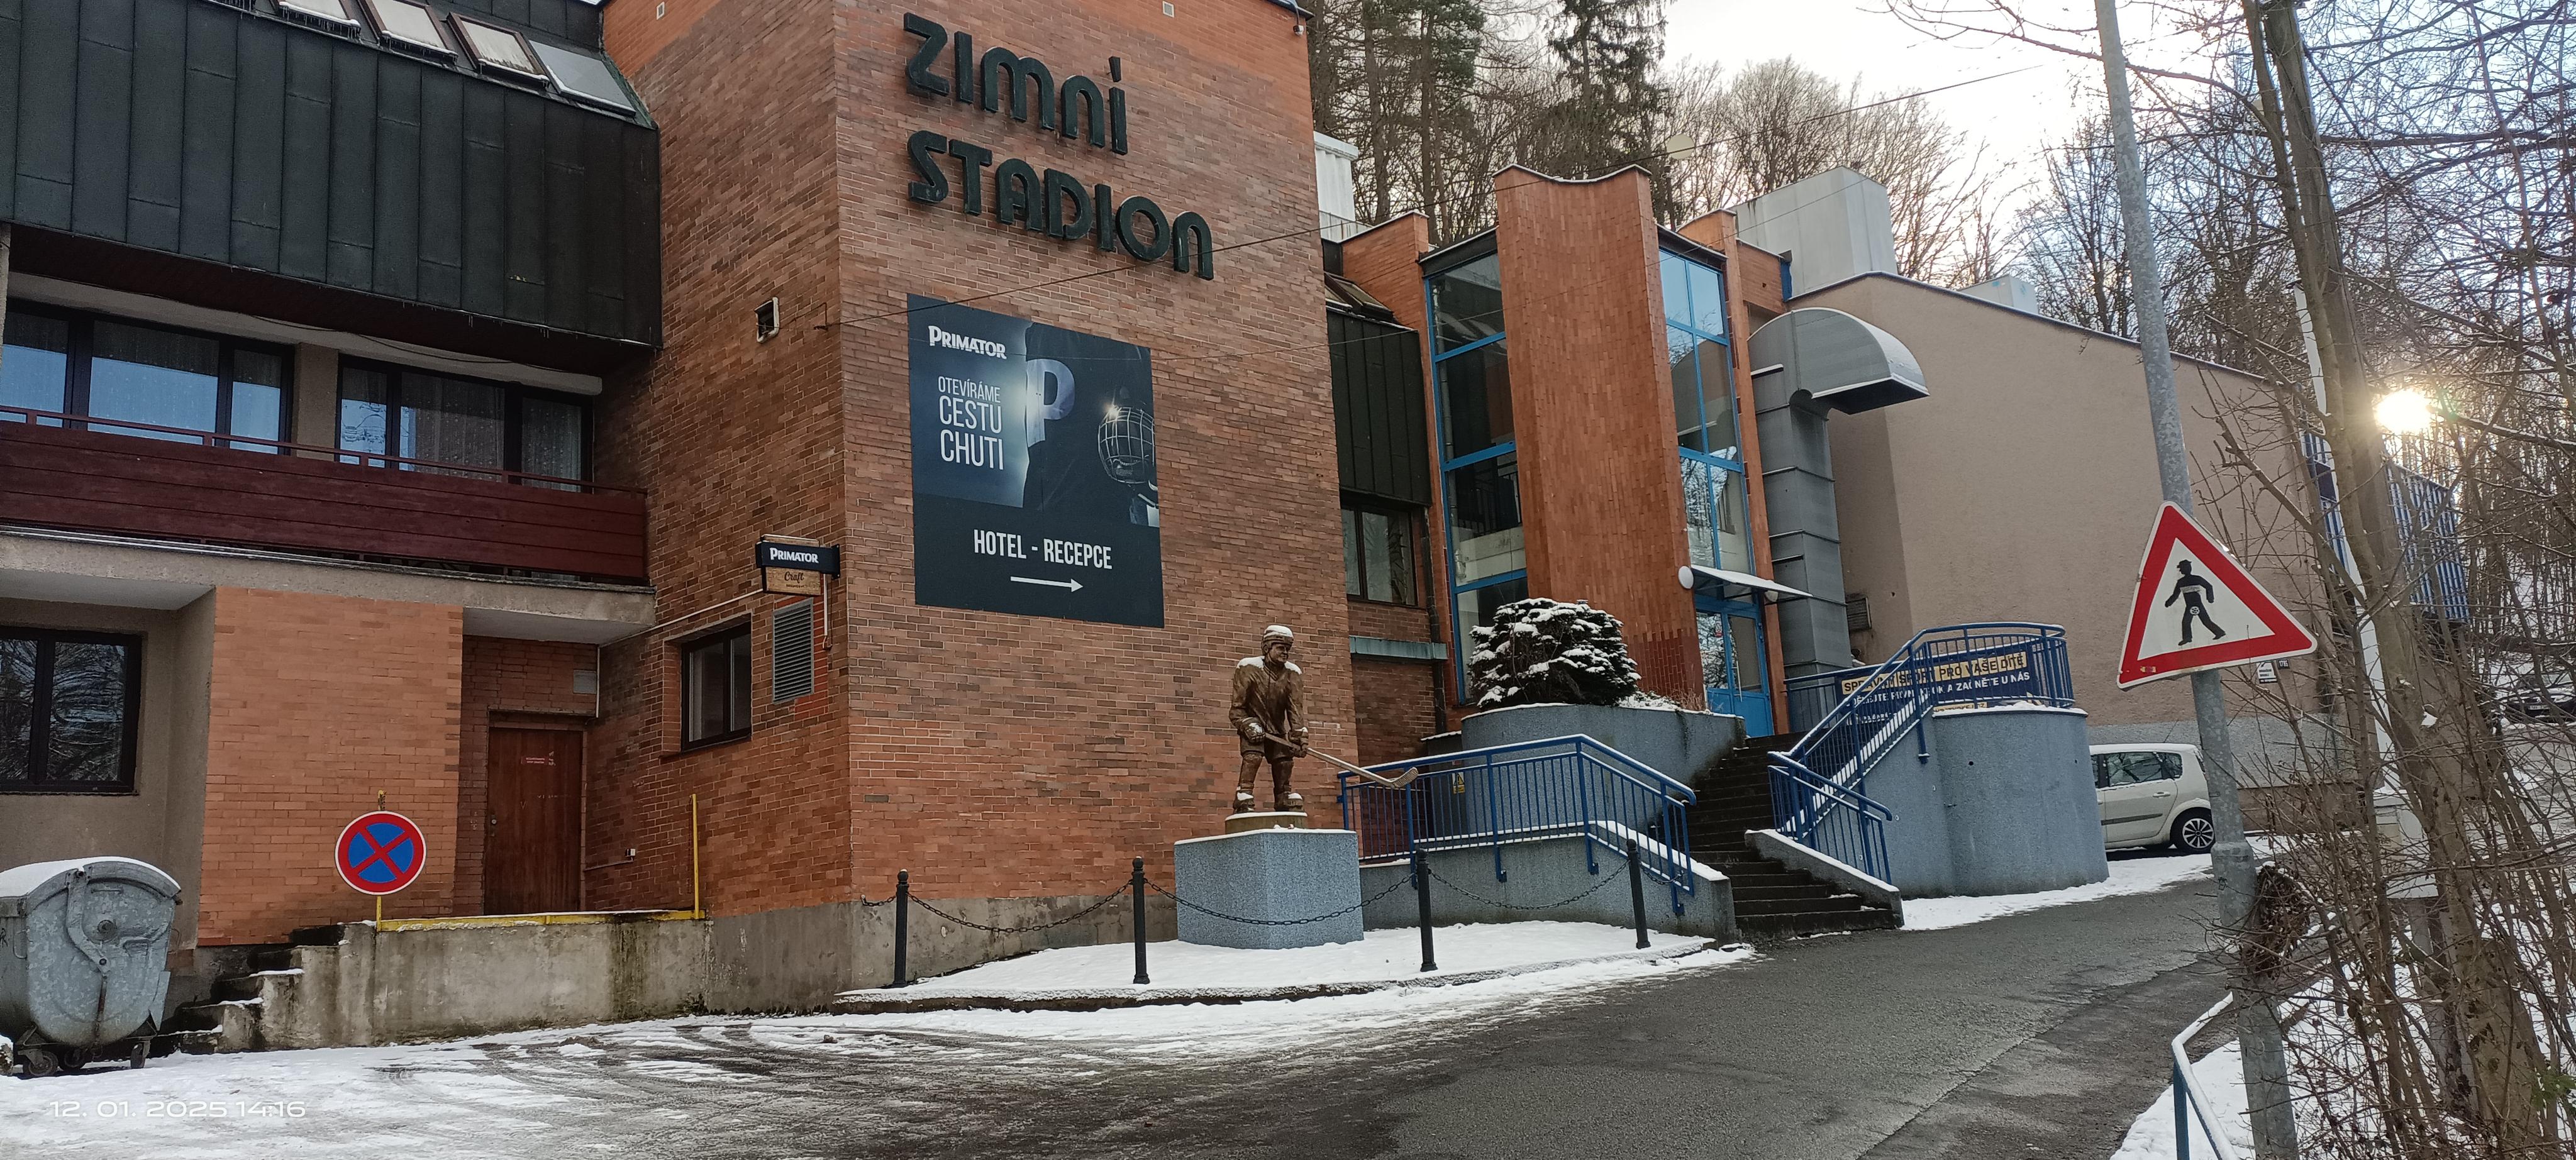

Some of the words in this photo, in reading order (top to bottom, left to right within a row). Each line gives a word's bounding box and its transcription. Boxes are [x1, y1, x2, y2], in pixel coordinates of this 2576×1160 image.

[928, 324, 1007, 360] PRIMATOR
[938, 376, 1001, 404] OTEVÍRÁME
[939, 395, 1002, 434] CESTU
[940, 429, 1004, 470] CHUTI
[769, 547, 819, 563] PRIMATOR
[974, 529, 1027, 560] HOTEL
[1043, 538, 1113, 570] RECEPCE
[784, 571, 804, 583] Craft
[1940, 666, 1962, 678] PRO
[1947, 684, 1953, 693] A
[2001, 676, 2008, 684] U
